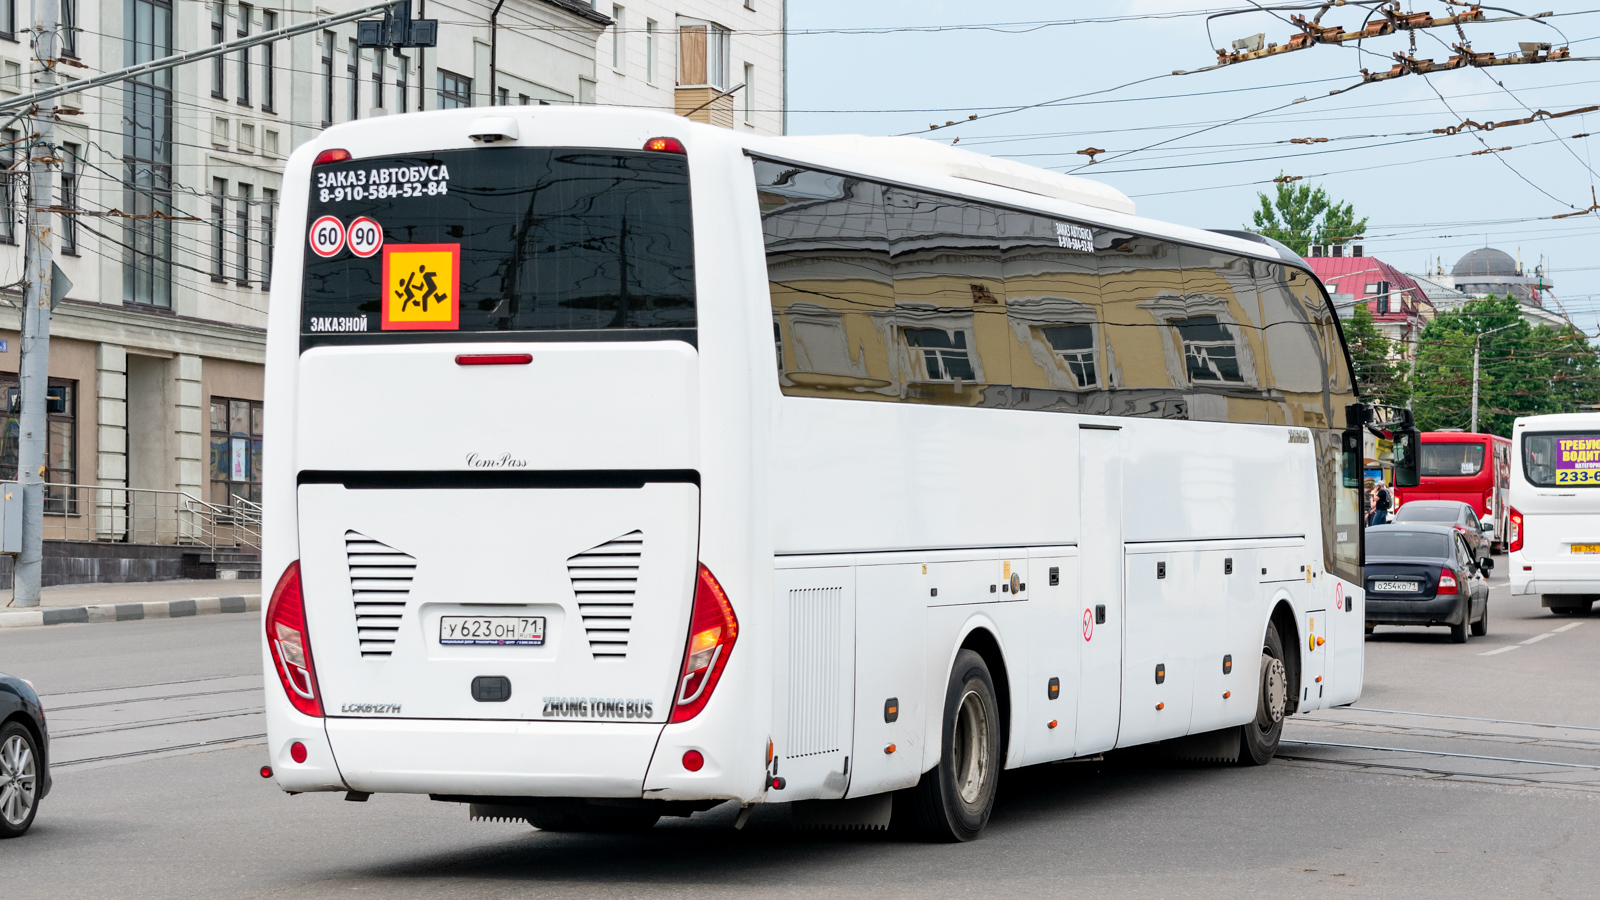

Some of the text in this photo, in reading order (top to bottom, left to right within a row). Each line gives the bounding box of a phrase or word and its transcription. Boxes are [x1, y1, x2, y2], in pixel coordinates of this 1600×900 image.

[317, 165, 449, 188] ЗАКАЗ АВТОБУСА
[319, 181, 448, 202] 8-910-584-52-84
[318, 227, 338, 245] 60
[355, 227, 375, 245] 90
[310, 314, 368, 332] ЗАКАЗНОЙ
[465, 452, 530, 468] ComPass
[1562, 450, 1600, 462] ВОДИТ
[1559, 471, 1600, 482] 233-6
[521, 619, 537, 633] 71
[341, 702, 402, 714] LCK6127H
[542, 697, 653, 719] ZHONG TONG BUS
